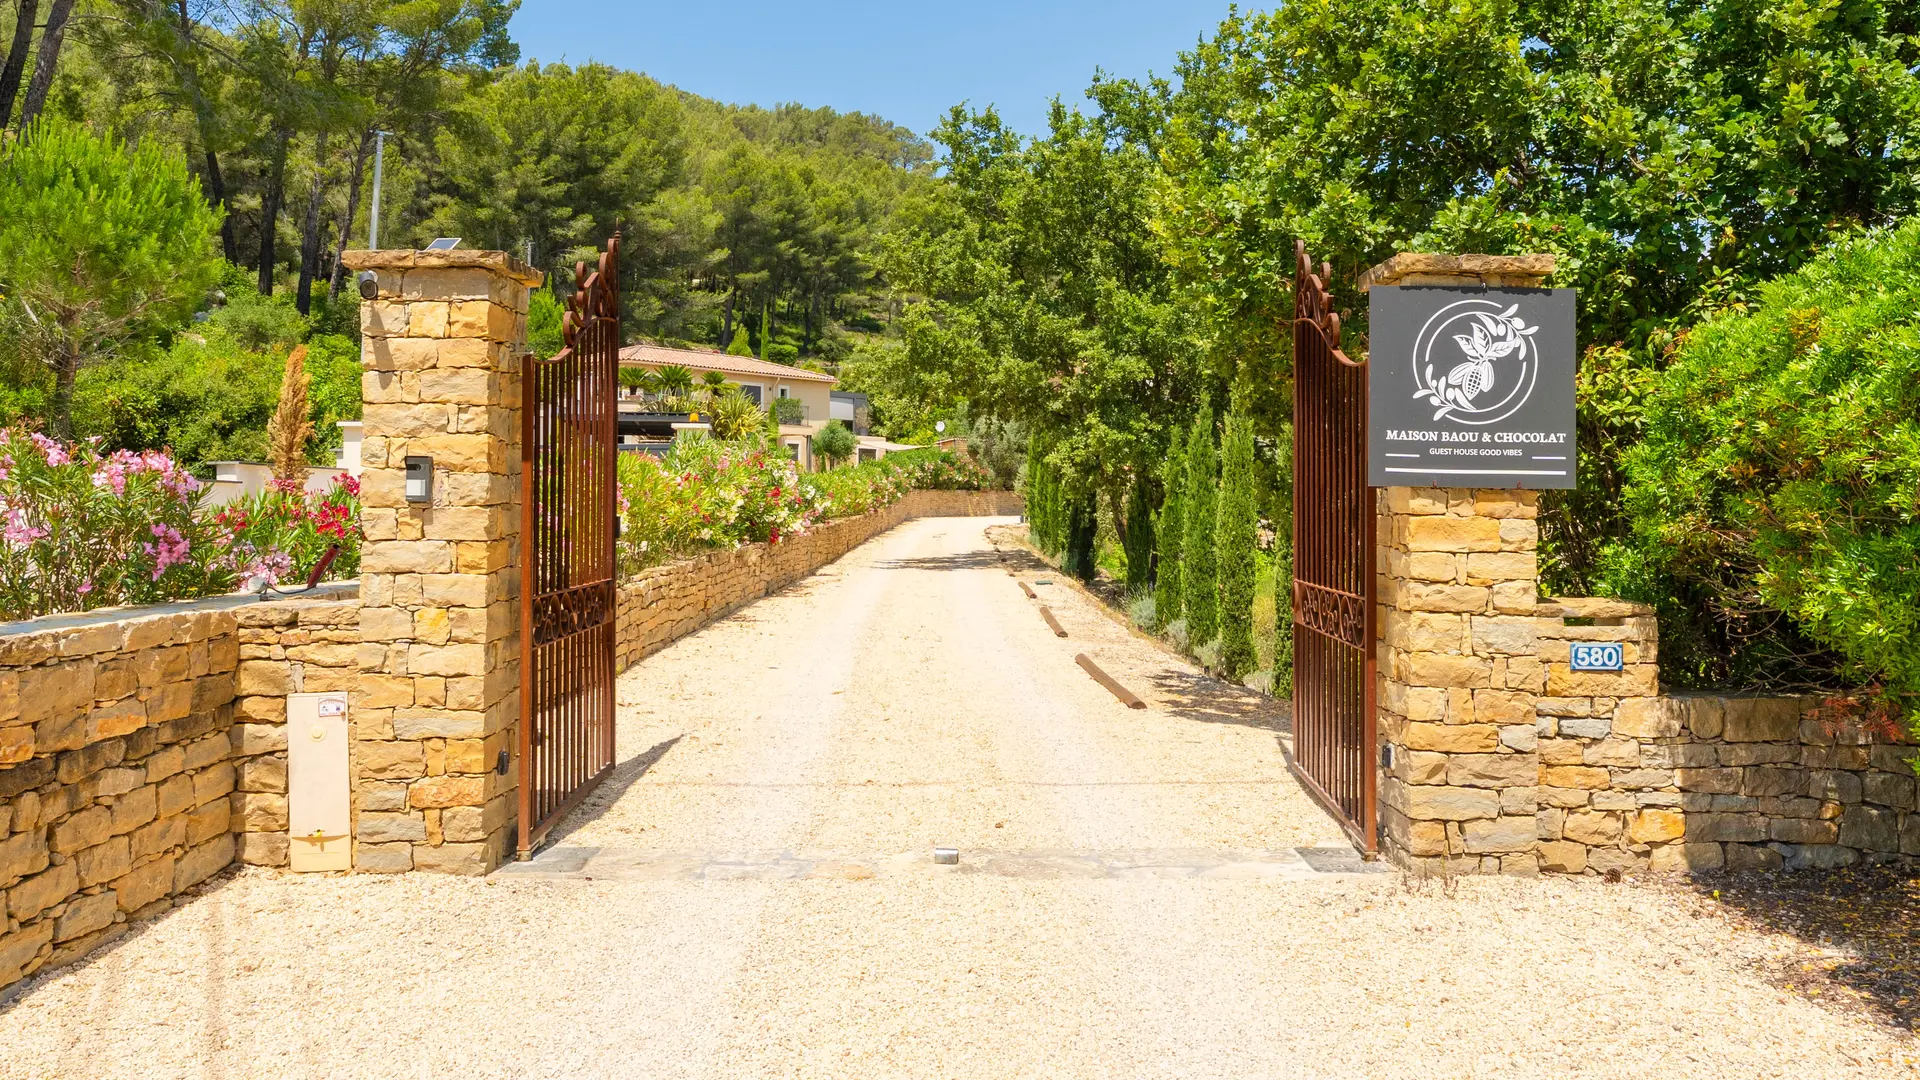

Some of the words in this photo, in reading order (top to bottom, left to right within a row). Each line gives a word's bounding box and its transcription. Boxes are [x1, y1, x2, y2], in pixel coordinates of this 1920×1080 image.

[1385, 429, 1439, 442] MAISON
[1441, 431, 1480, 443] BAOU
[1481, 432, 1492, 443] &
[1494, 432, 1567, 443] CHOCOLAT
[1429, 447, 1453, 456] GUEST
[1453, 448, 1479, 456] HOUSE
[1479, 448, 1502, 456] GOOD
[1502, 448, 1523, 457] VIBES
[1577, 647, 1618, 667] 580
